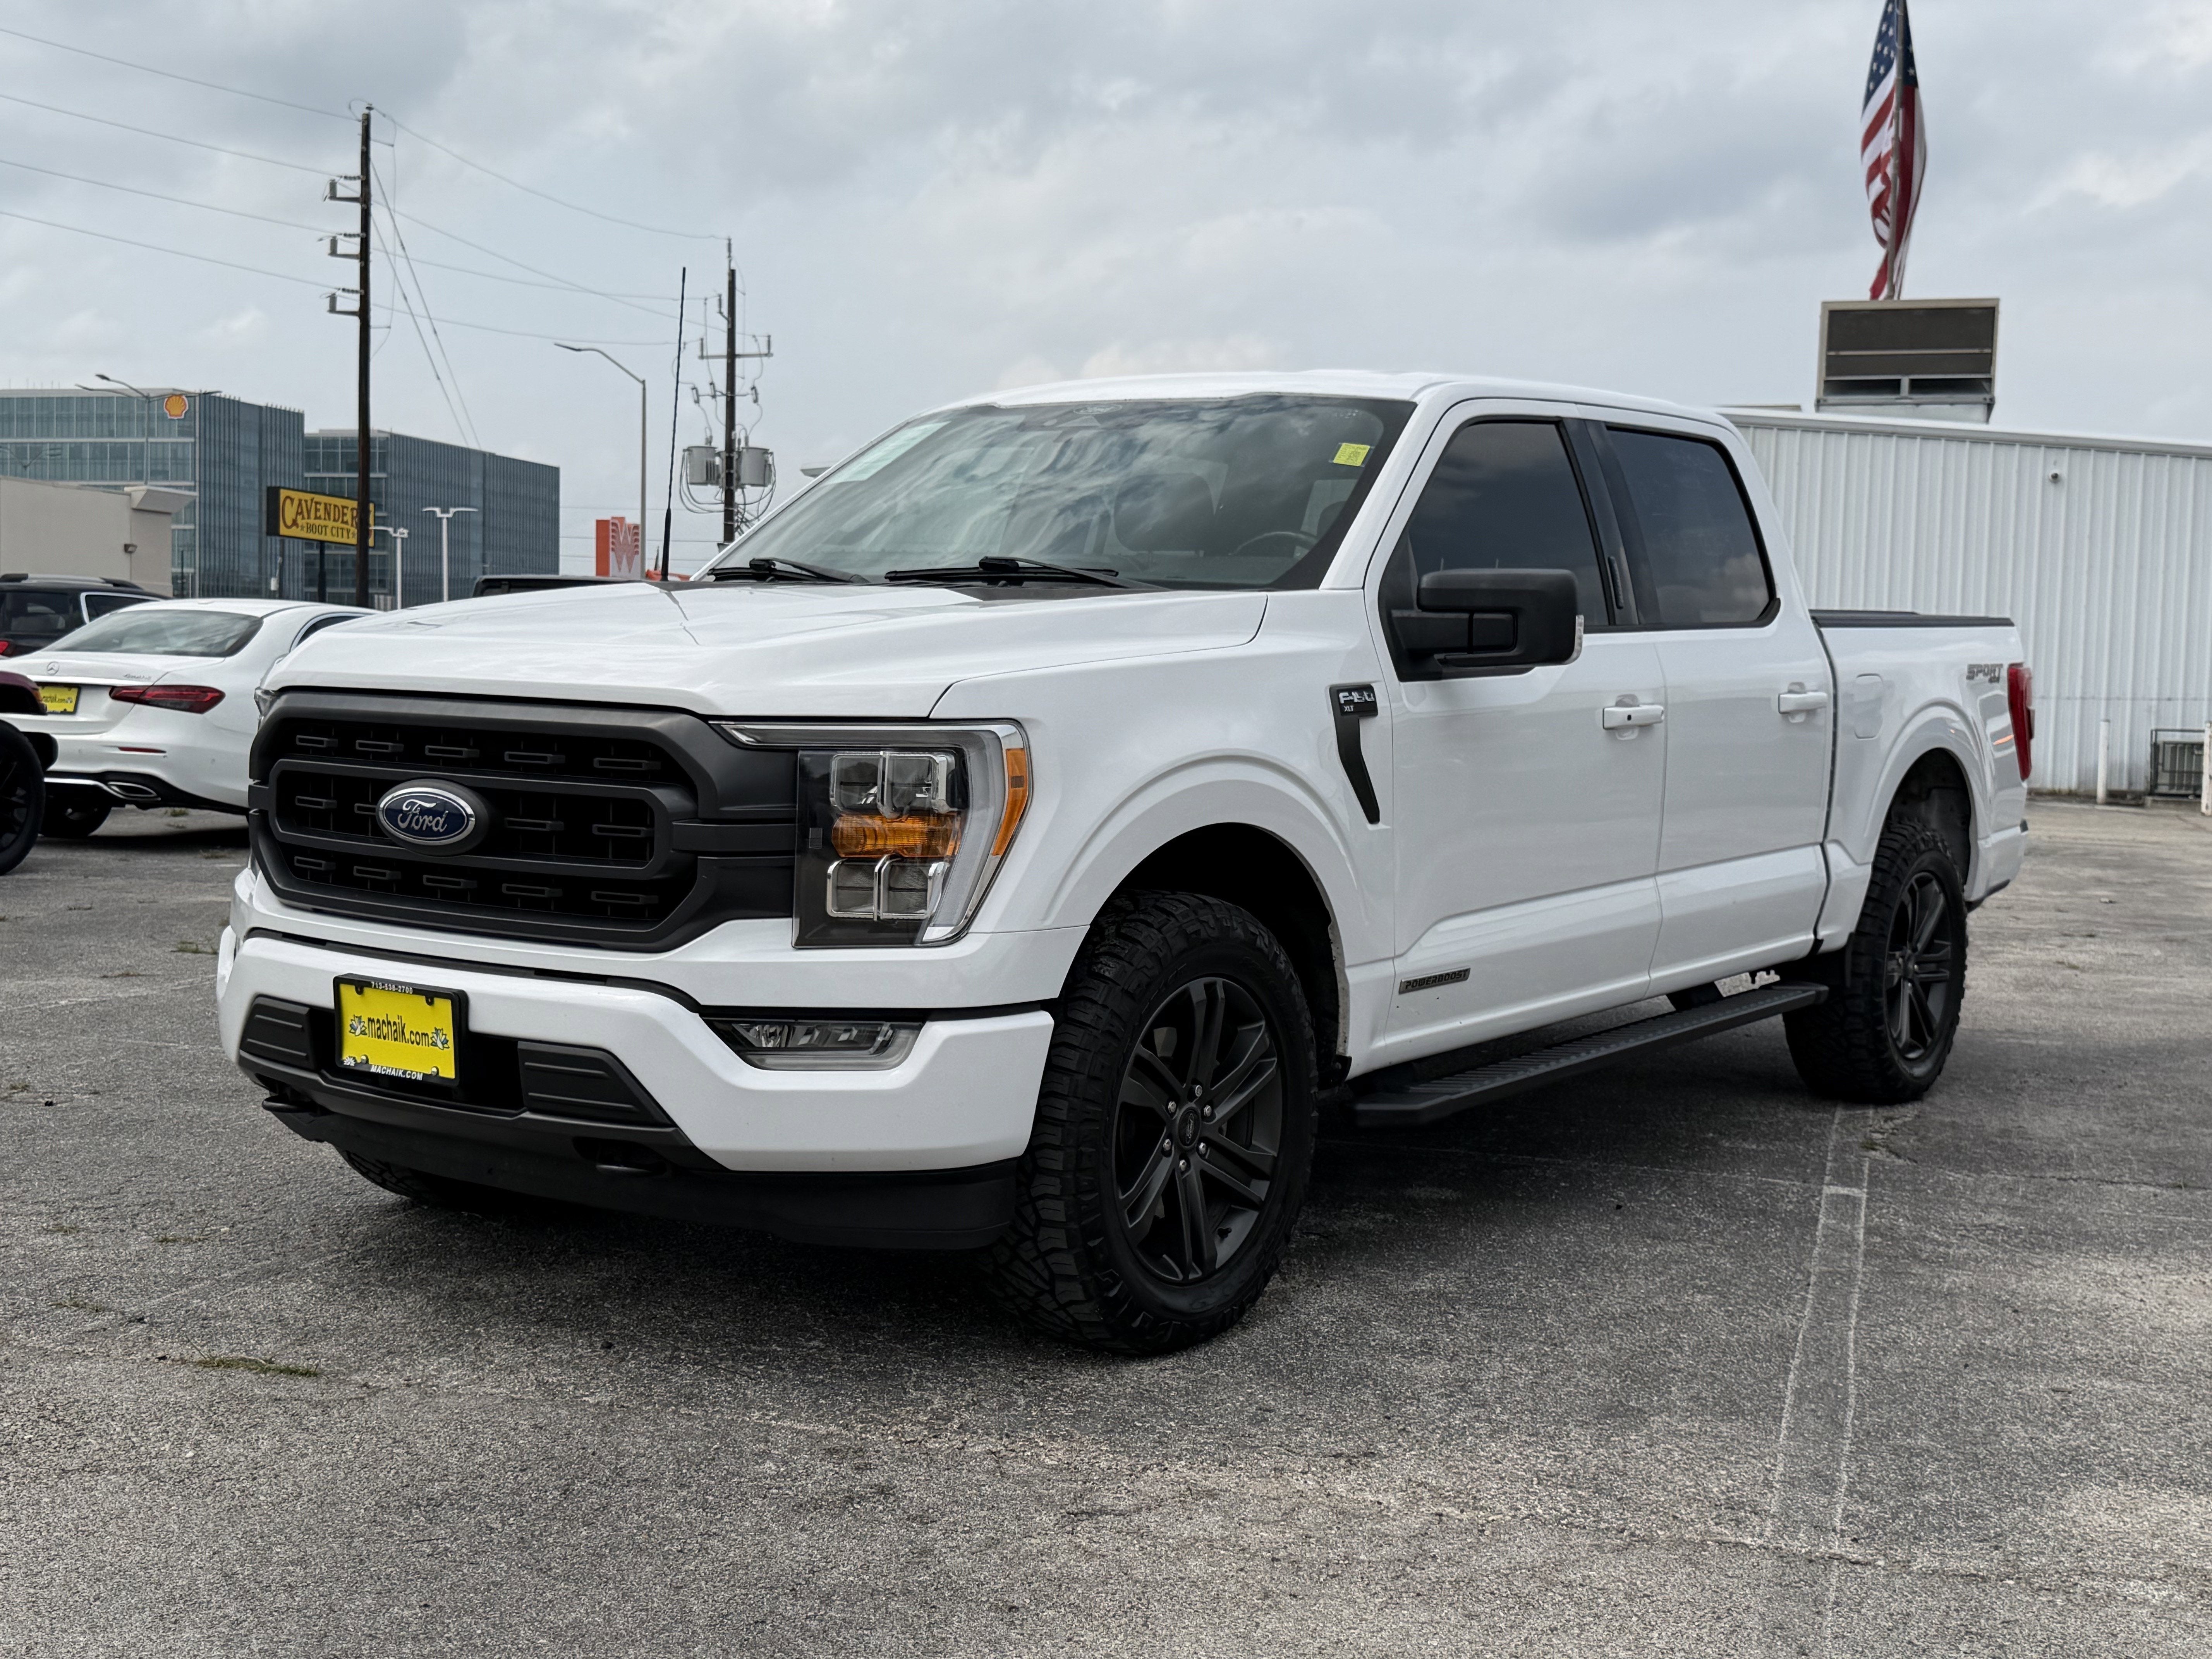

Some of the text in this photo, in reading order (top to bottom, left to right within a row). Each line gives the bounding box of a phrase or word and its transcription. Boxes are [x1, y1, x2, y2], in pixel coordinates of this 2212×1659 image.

[306, 523, 351, 539] BOOT CITY
[1966, 664, 2003, 680] SPORT
[398, 799, 448, 832] Ford
[368, 1013, 430, 1047] machaik.com
[370, 1065, 423, 1081] MACHAIK.COM
